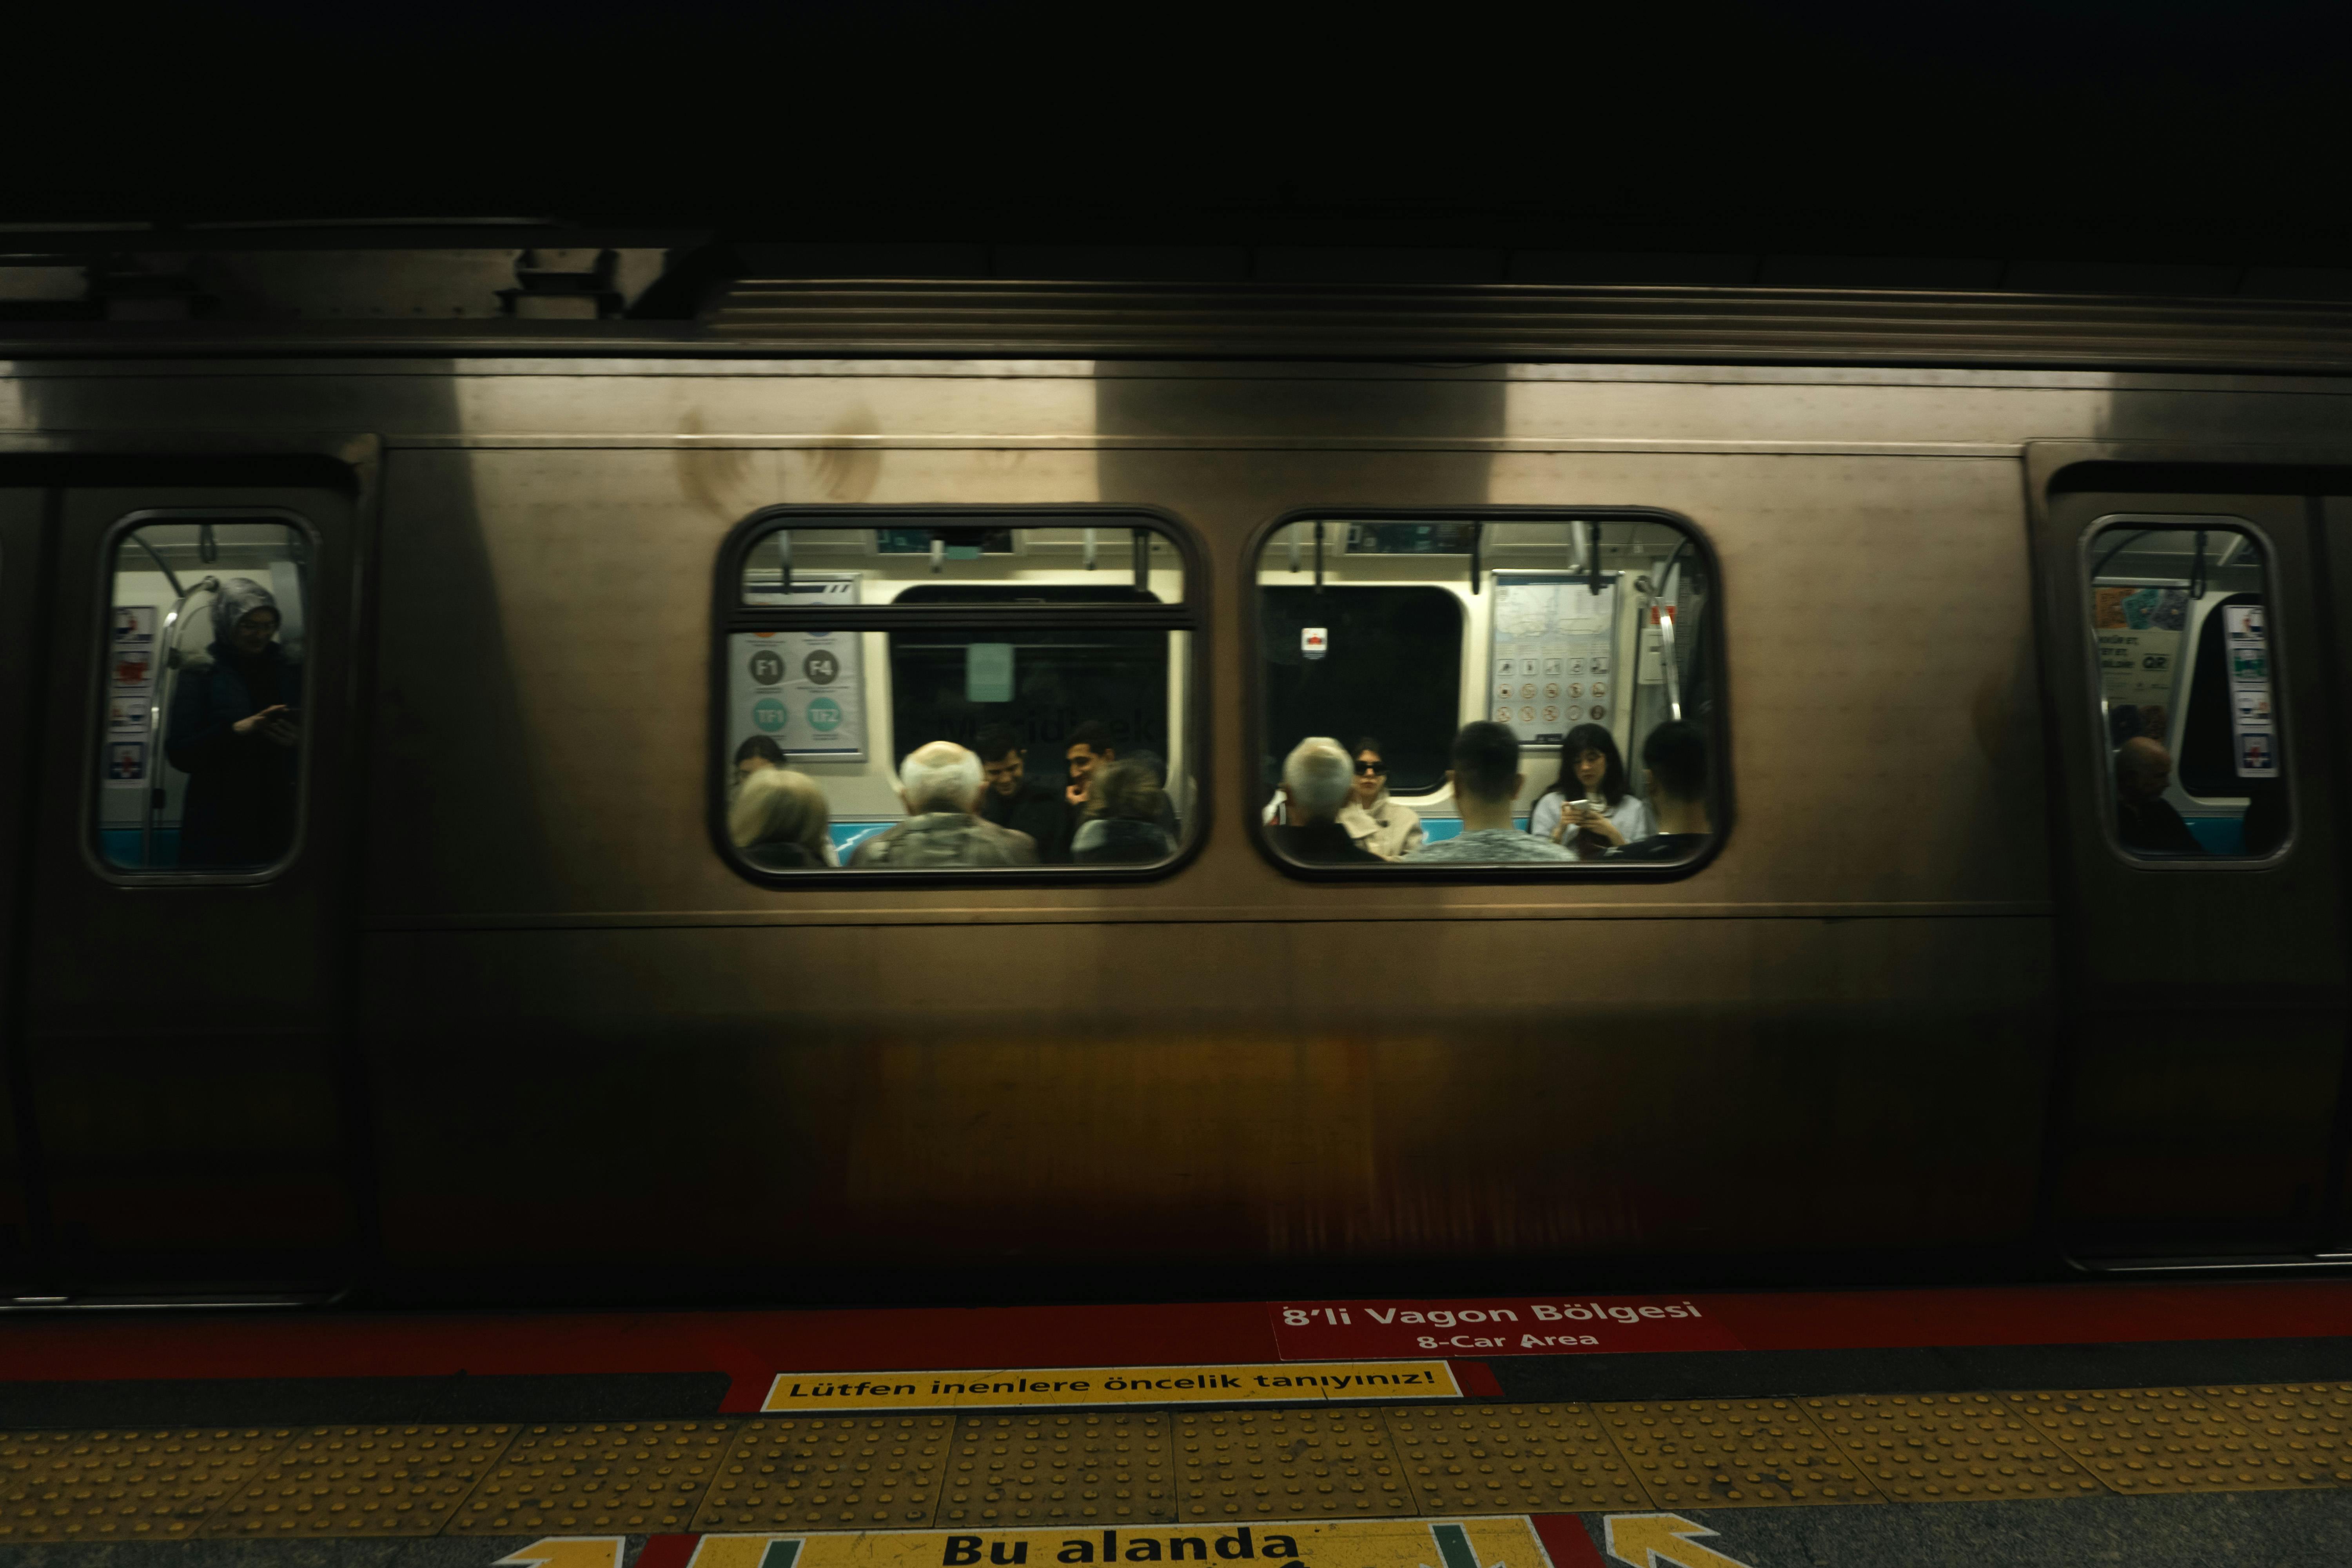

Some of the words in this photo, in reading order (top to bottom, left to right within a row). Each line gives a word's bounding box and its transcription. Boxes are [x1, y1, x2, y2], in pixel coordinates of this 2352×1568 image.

[755, 659, 778, 675] F1
[809, 660, 833, 675] F4
[758, 709, 784, 722] TF1
[810, 708, 838, 722] TF2
[1364, 1308, 1518, 1328] Vagon
[1531, 1301, 1702, 1323] Bölgesi
[1417, 1336, 1506, 1349] 8-Car
[1520, 1334, 1599, 1348] Area
[790, 1382, 916, 1397] Lütfen
[931, 1379, 1090, 1394] inenlere
[1104, 1374, 1241, 1390] öncelik
[1253, 1371, 1435, 1390] tanıyınız!
[942, 1535, 1028, 1566] Bu
[1057, 1526, 1299, 1564] alanda
